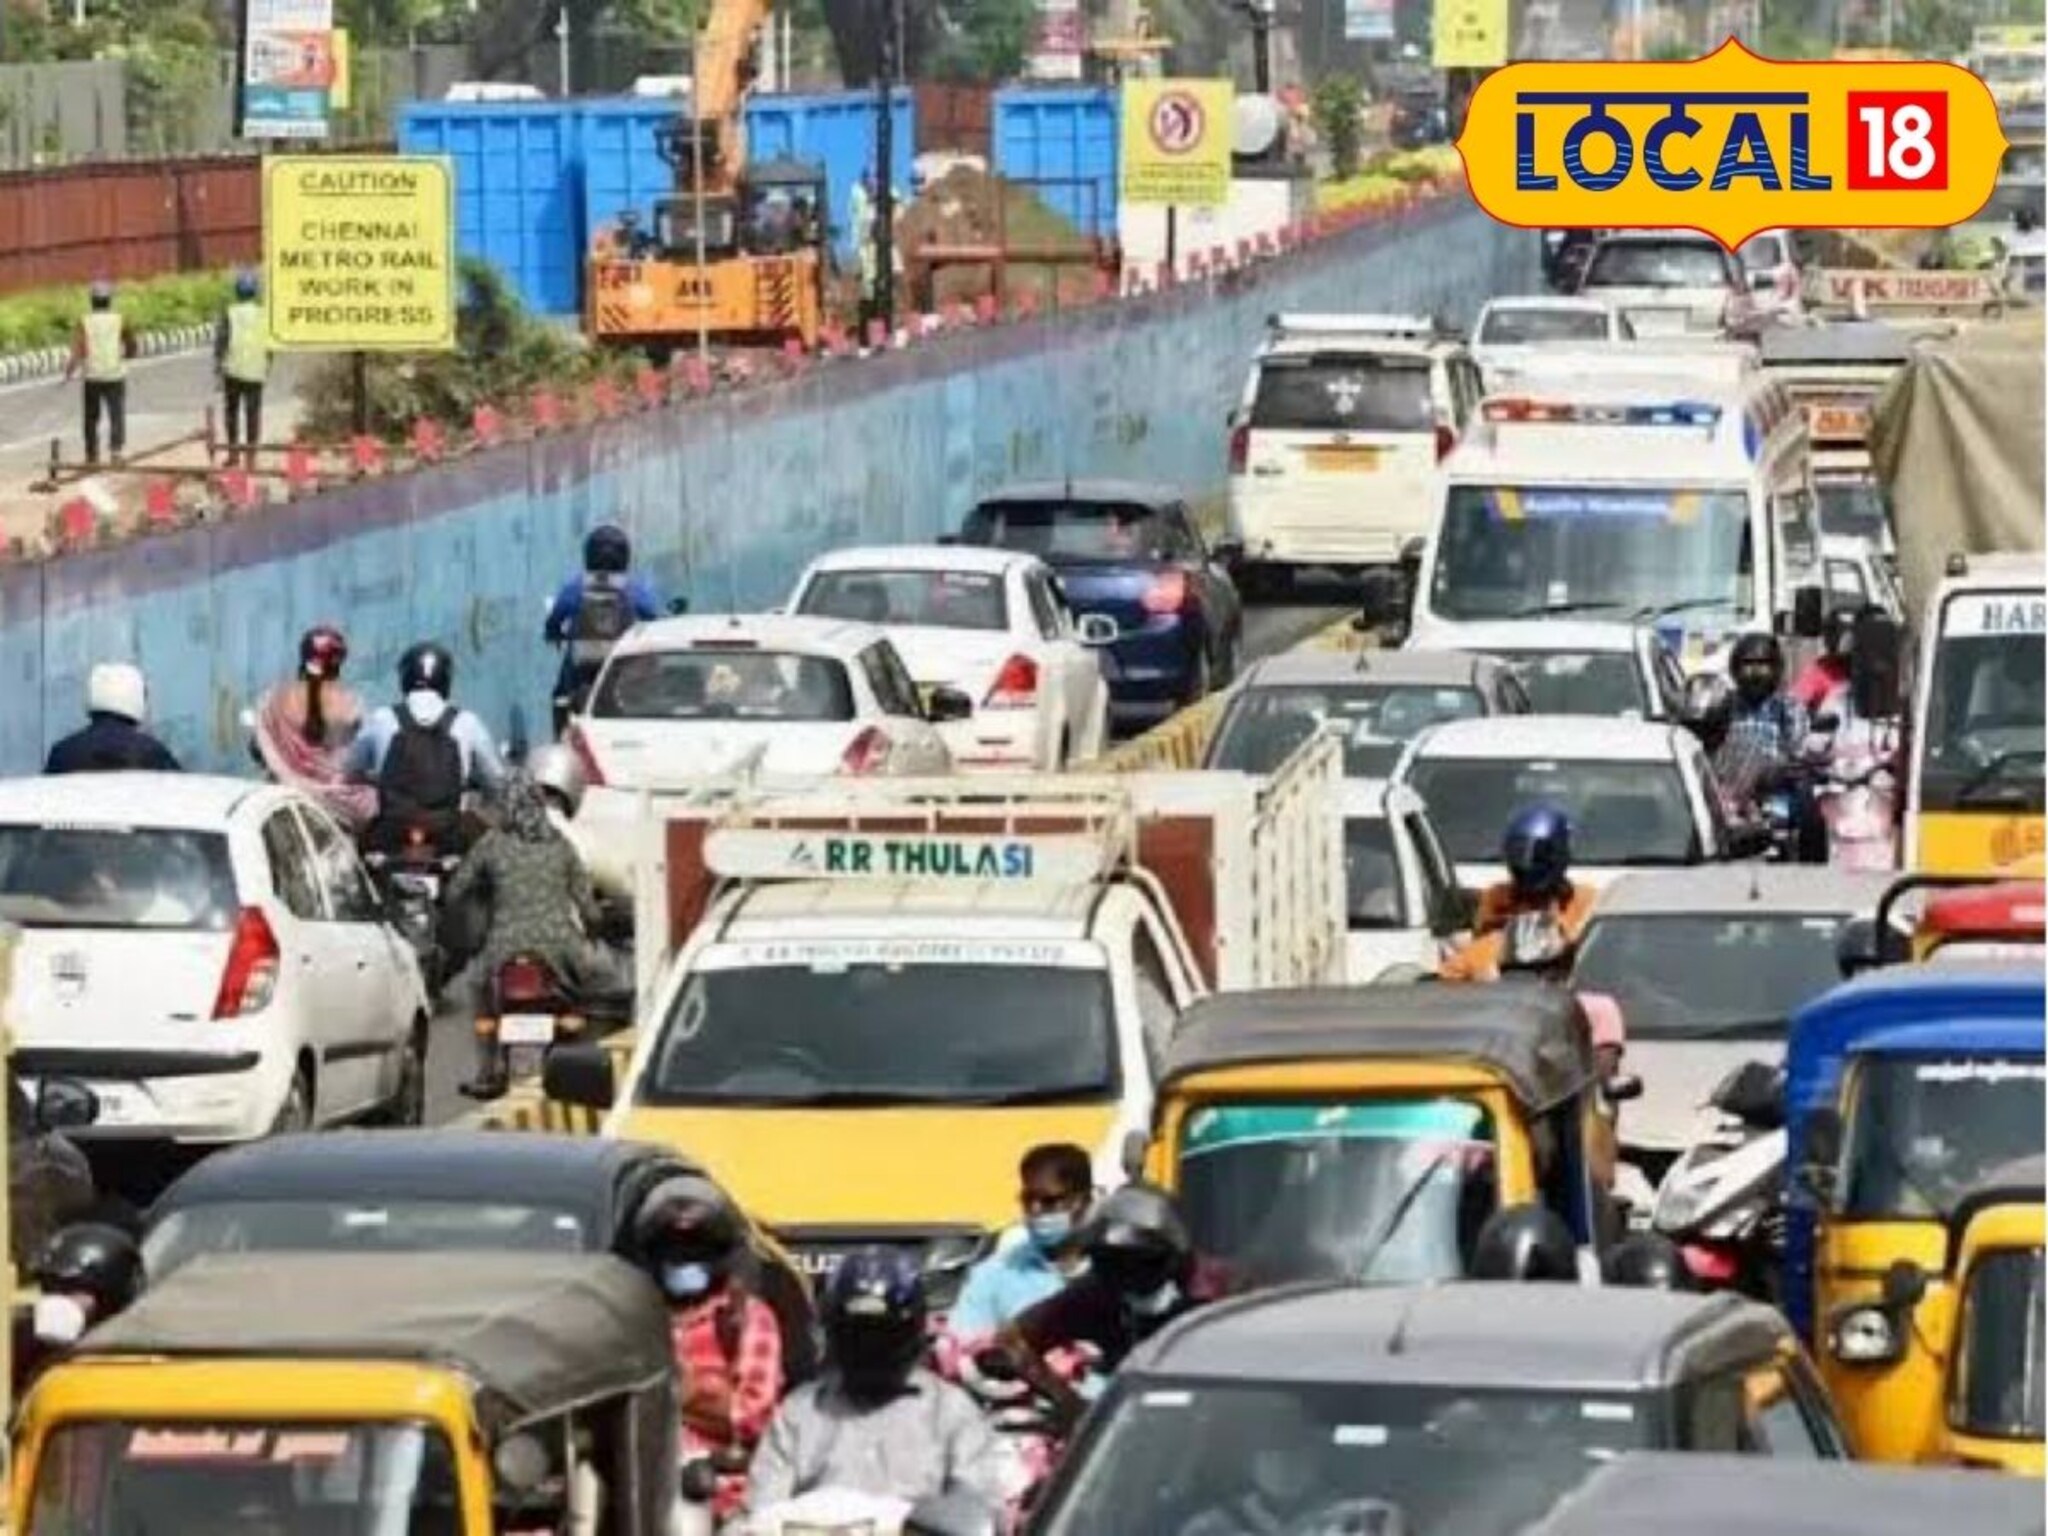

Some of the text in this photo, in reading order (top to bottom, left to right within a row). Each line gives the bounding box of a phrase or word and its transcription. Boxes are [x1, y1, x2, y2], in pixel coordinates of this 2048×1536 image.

[298, 172, 417, 191] CAUTION
[301, 221, 417, 241] CHENNAI
[280, 250, 438, 269] METRO RAIL
[299, 277, 414, 296] WORK IN
[288, 306, 434, 325] PROGRESS
[826, 840, 1033, 876] RR THULASI
